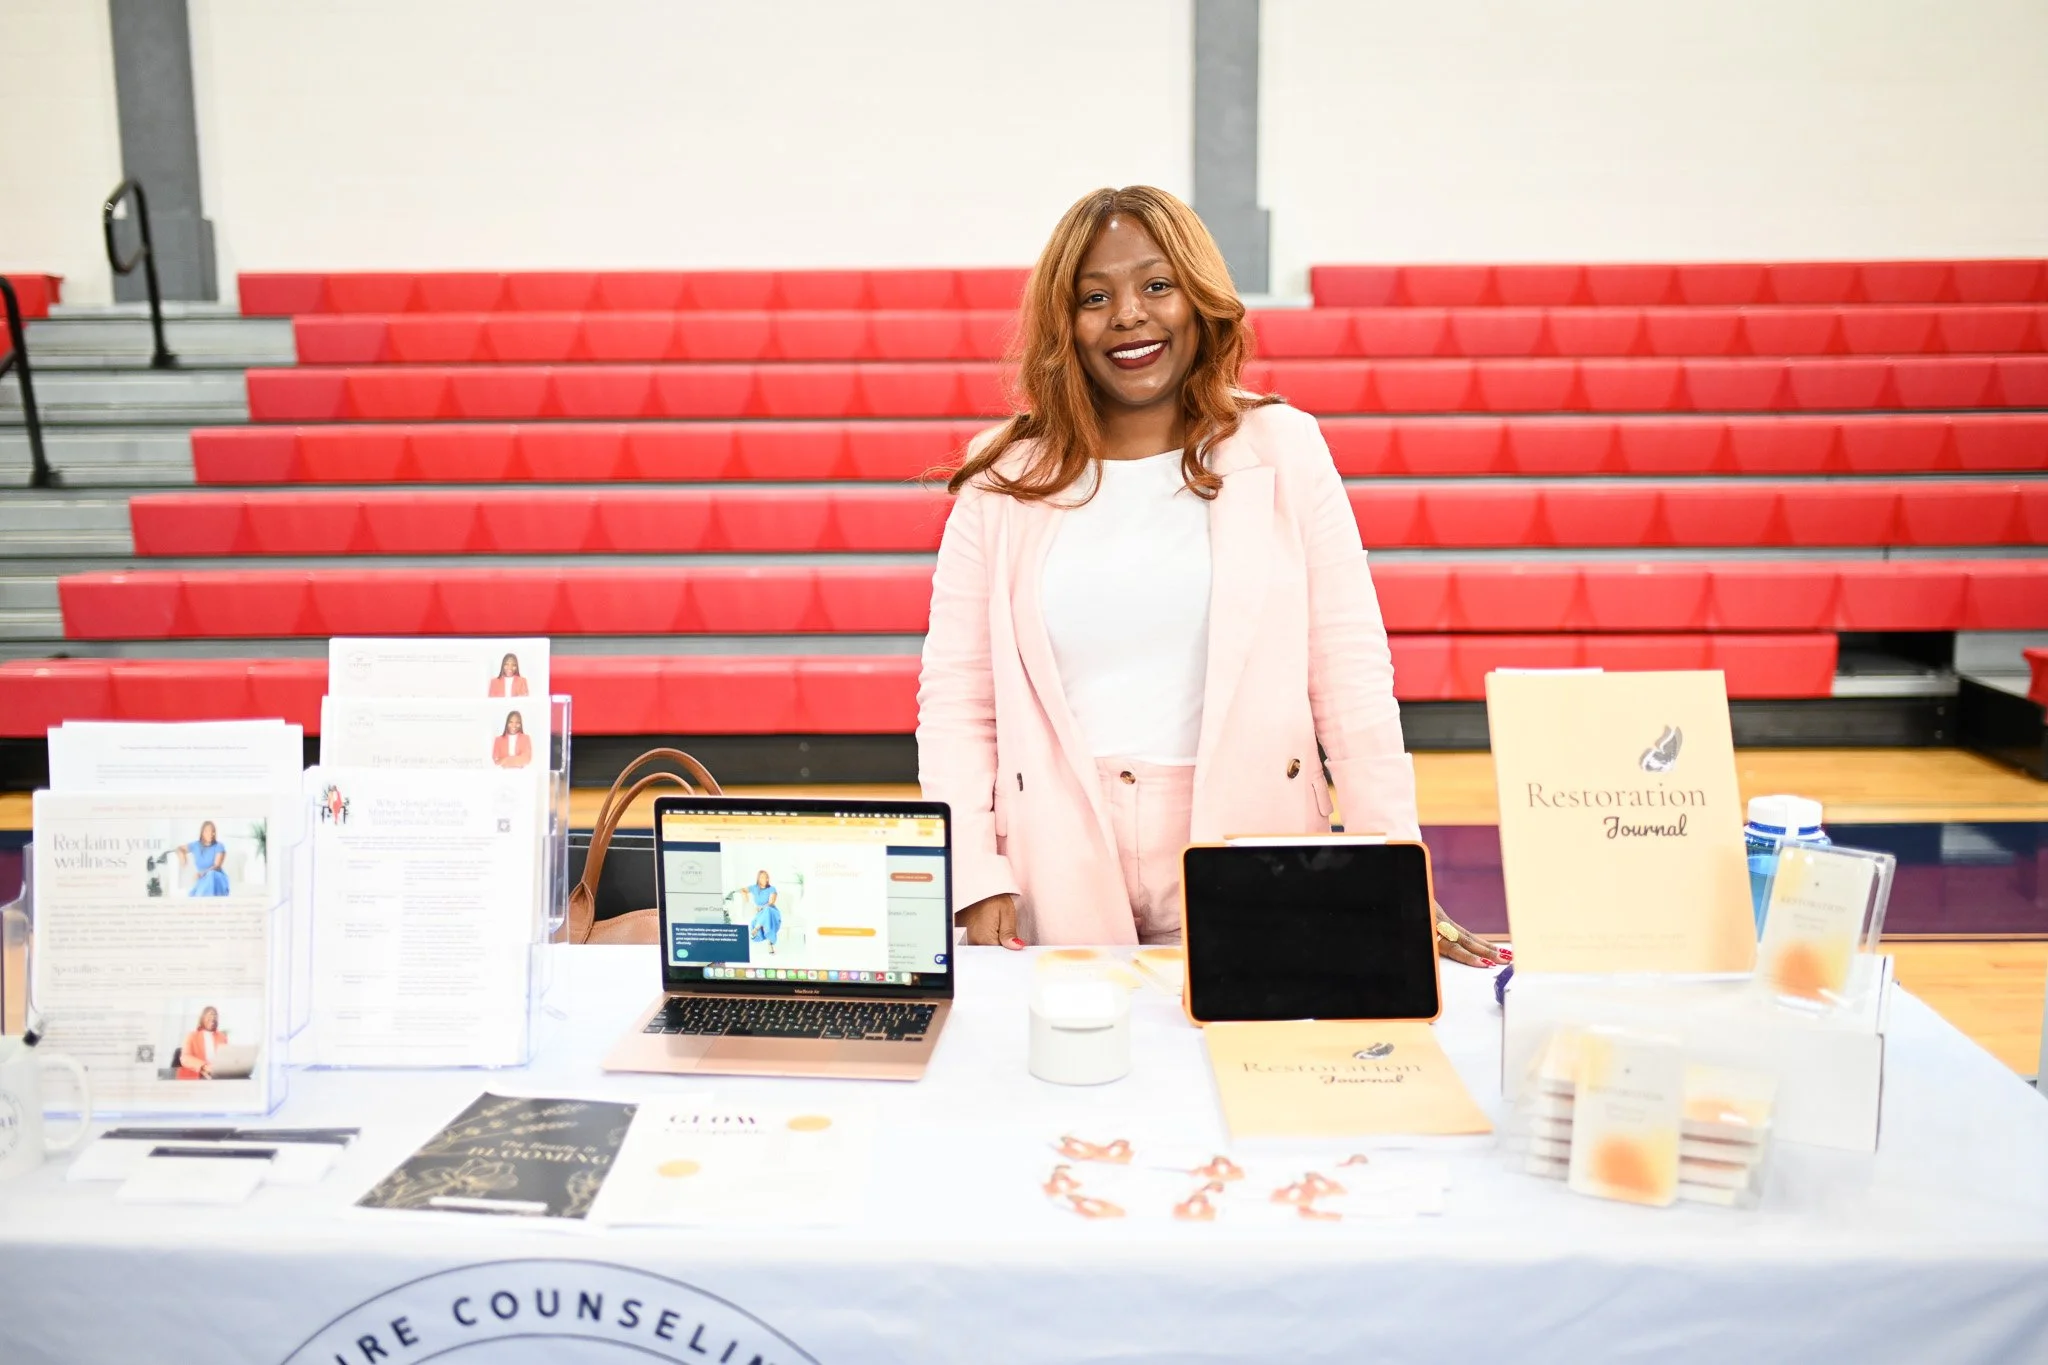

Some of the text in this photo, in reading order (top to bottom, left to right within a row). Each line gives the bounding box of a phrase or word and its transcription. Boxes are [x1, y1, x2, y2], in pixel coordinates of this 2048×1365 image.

[1527, 782, 1707, 808] Restoration
[1603, 813, 1688, 839] Journal
[53, 832, 164, 855] Reclaim your
[53, 851, 128, 868] wellness
[1242, 1061, 1422, 1073] Restoration
[1320, 1074, 1404, 1085] Journal
[467, 1147, 611, 1165] BLOOMING
